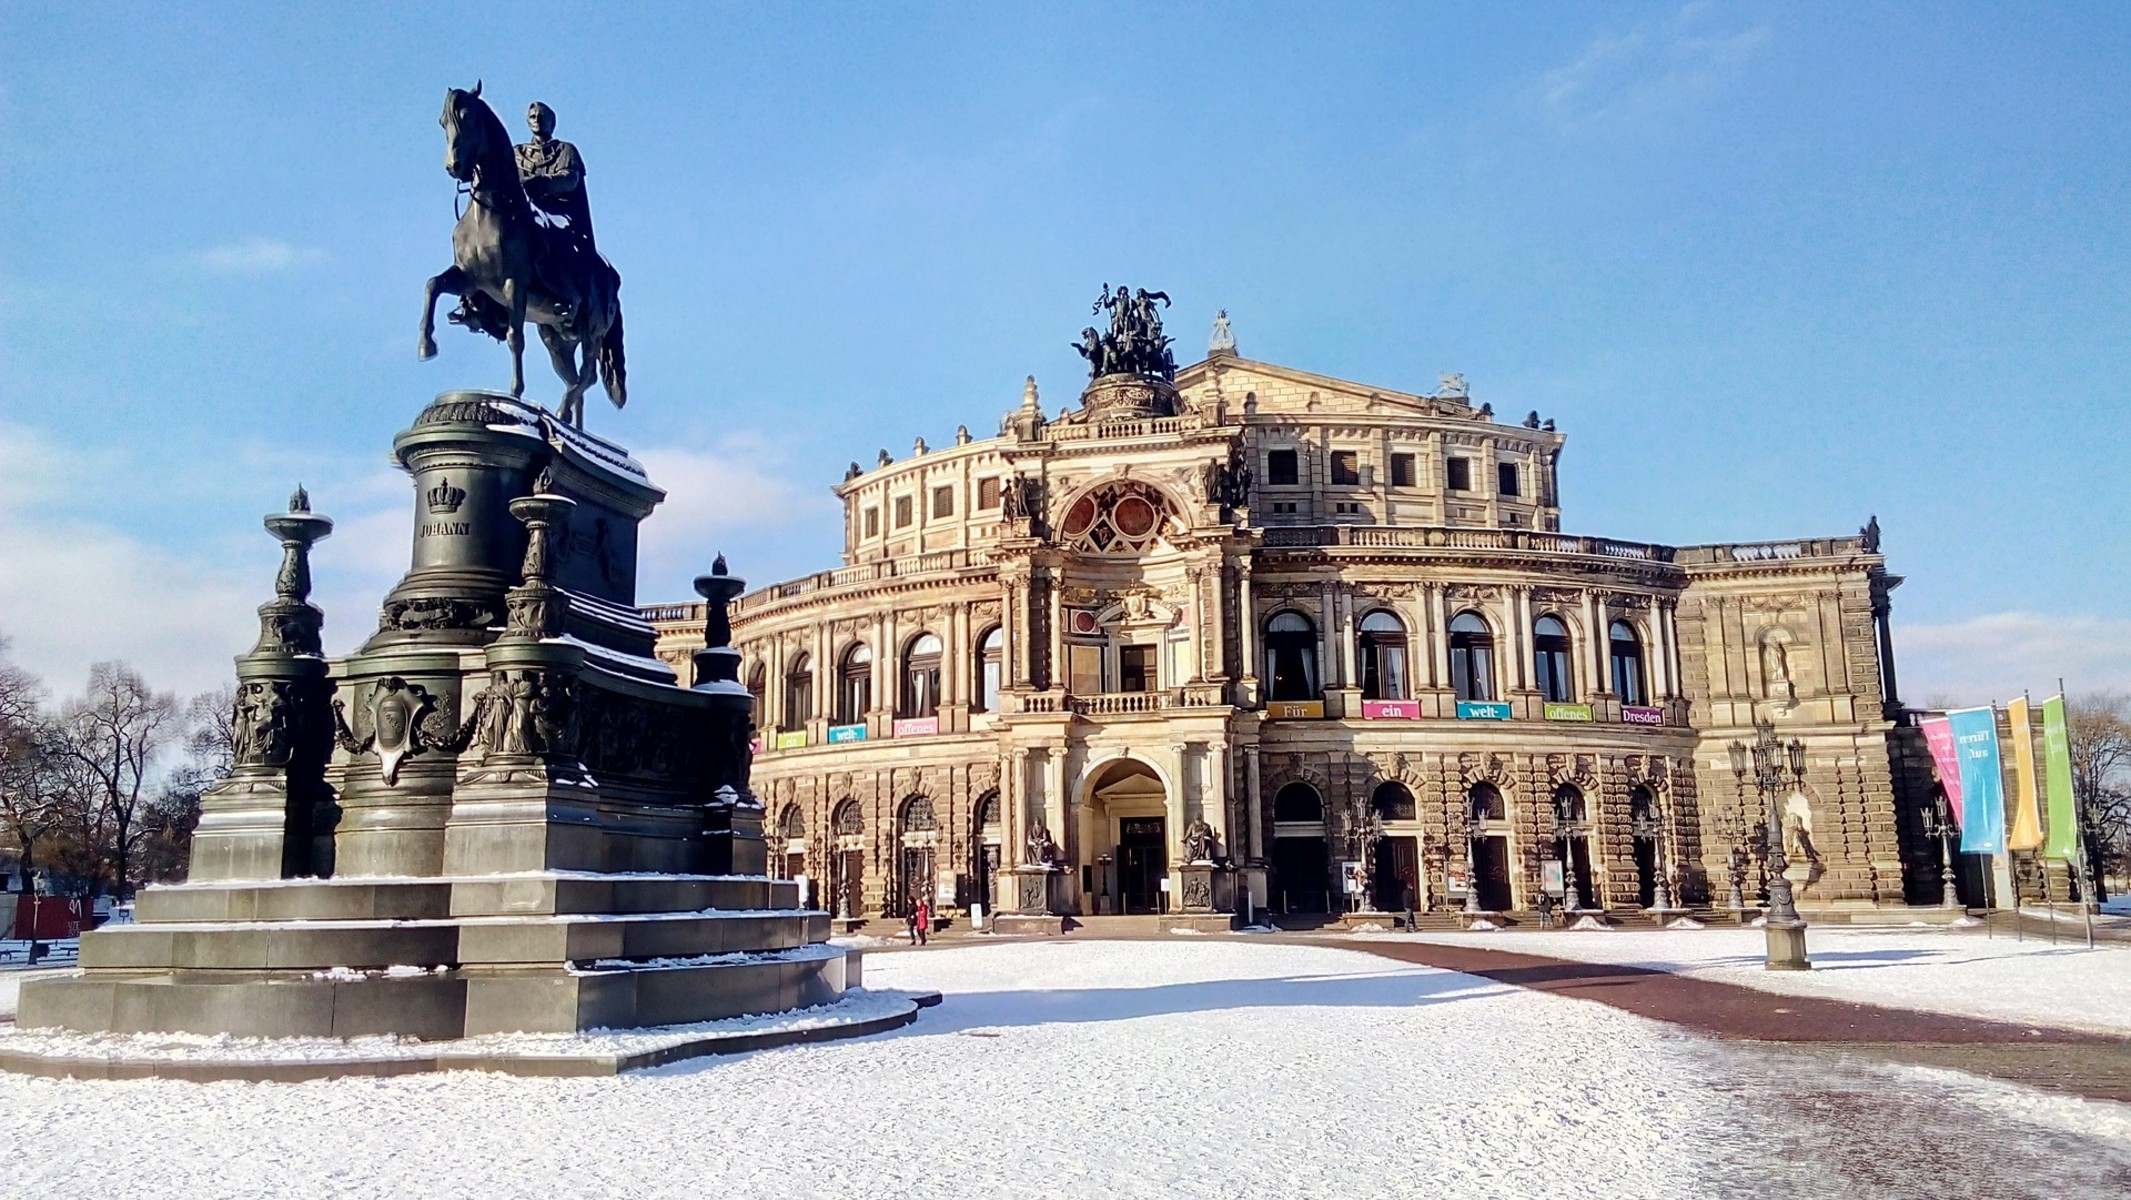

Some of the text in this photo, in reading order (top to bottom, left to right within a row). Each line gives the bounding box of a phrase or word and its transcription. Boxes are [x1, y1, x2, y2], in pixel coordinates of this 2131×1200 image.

[420, 522, 471, 538] JOHANN
[1283, 704, 1662, 724] Für ein welt- offenes Dresden
[898, 723, 934, 735] offenes
